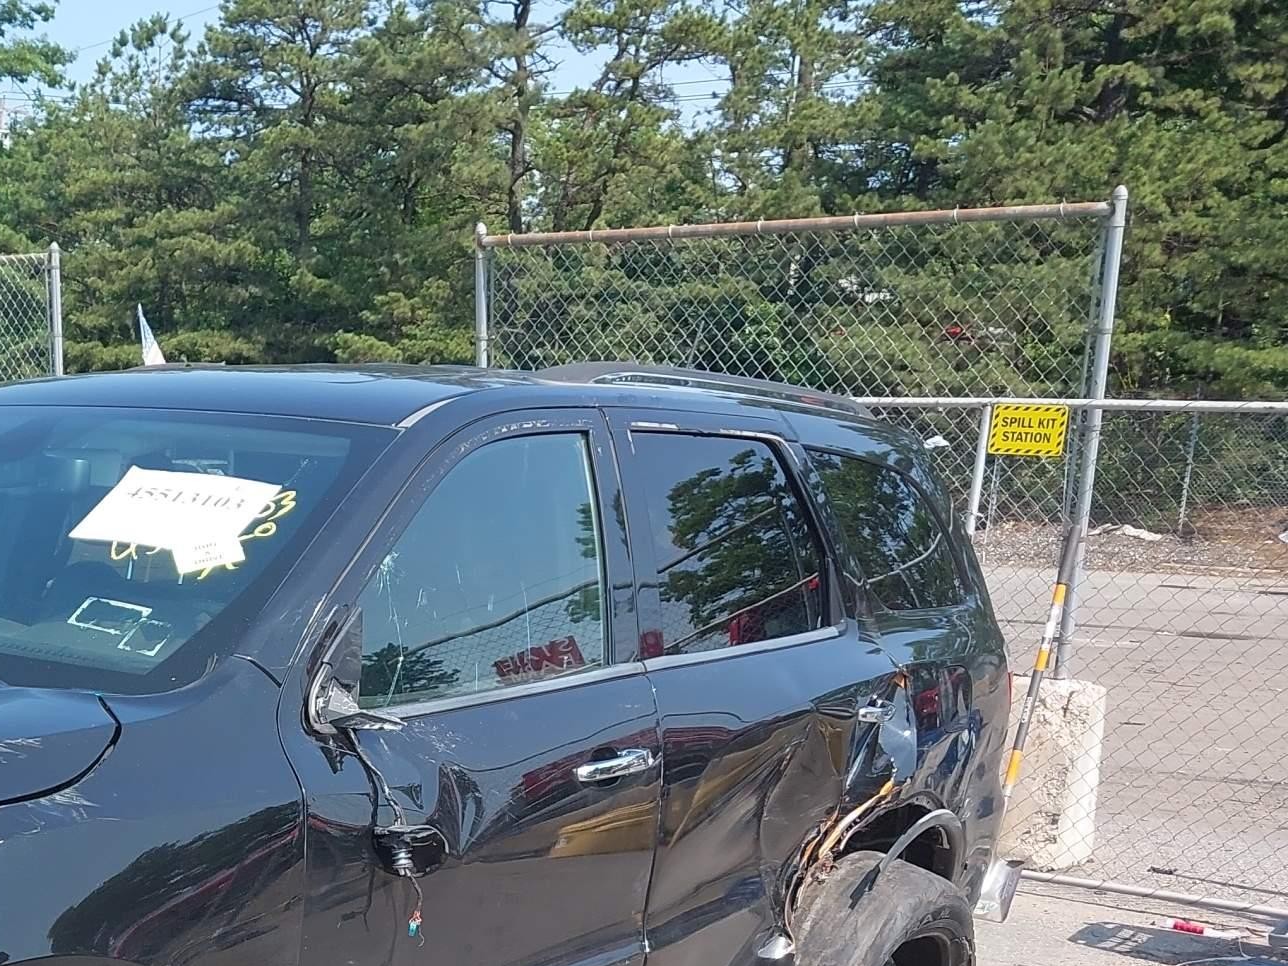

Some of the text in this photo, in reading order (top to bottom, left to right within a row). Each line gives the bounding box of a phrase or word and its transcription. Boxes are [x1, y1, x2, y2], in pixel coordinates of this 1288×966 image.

[1001, 416, 1057, 430] SPILL KIT
[1001, 430, 1052, 443] STATION
